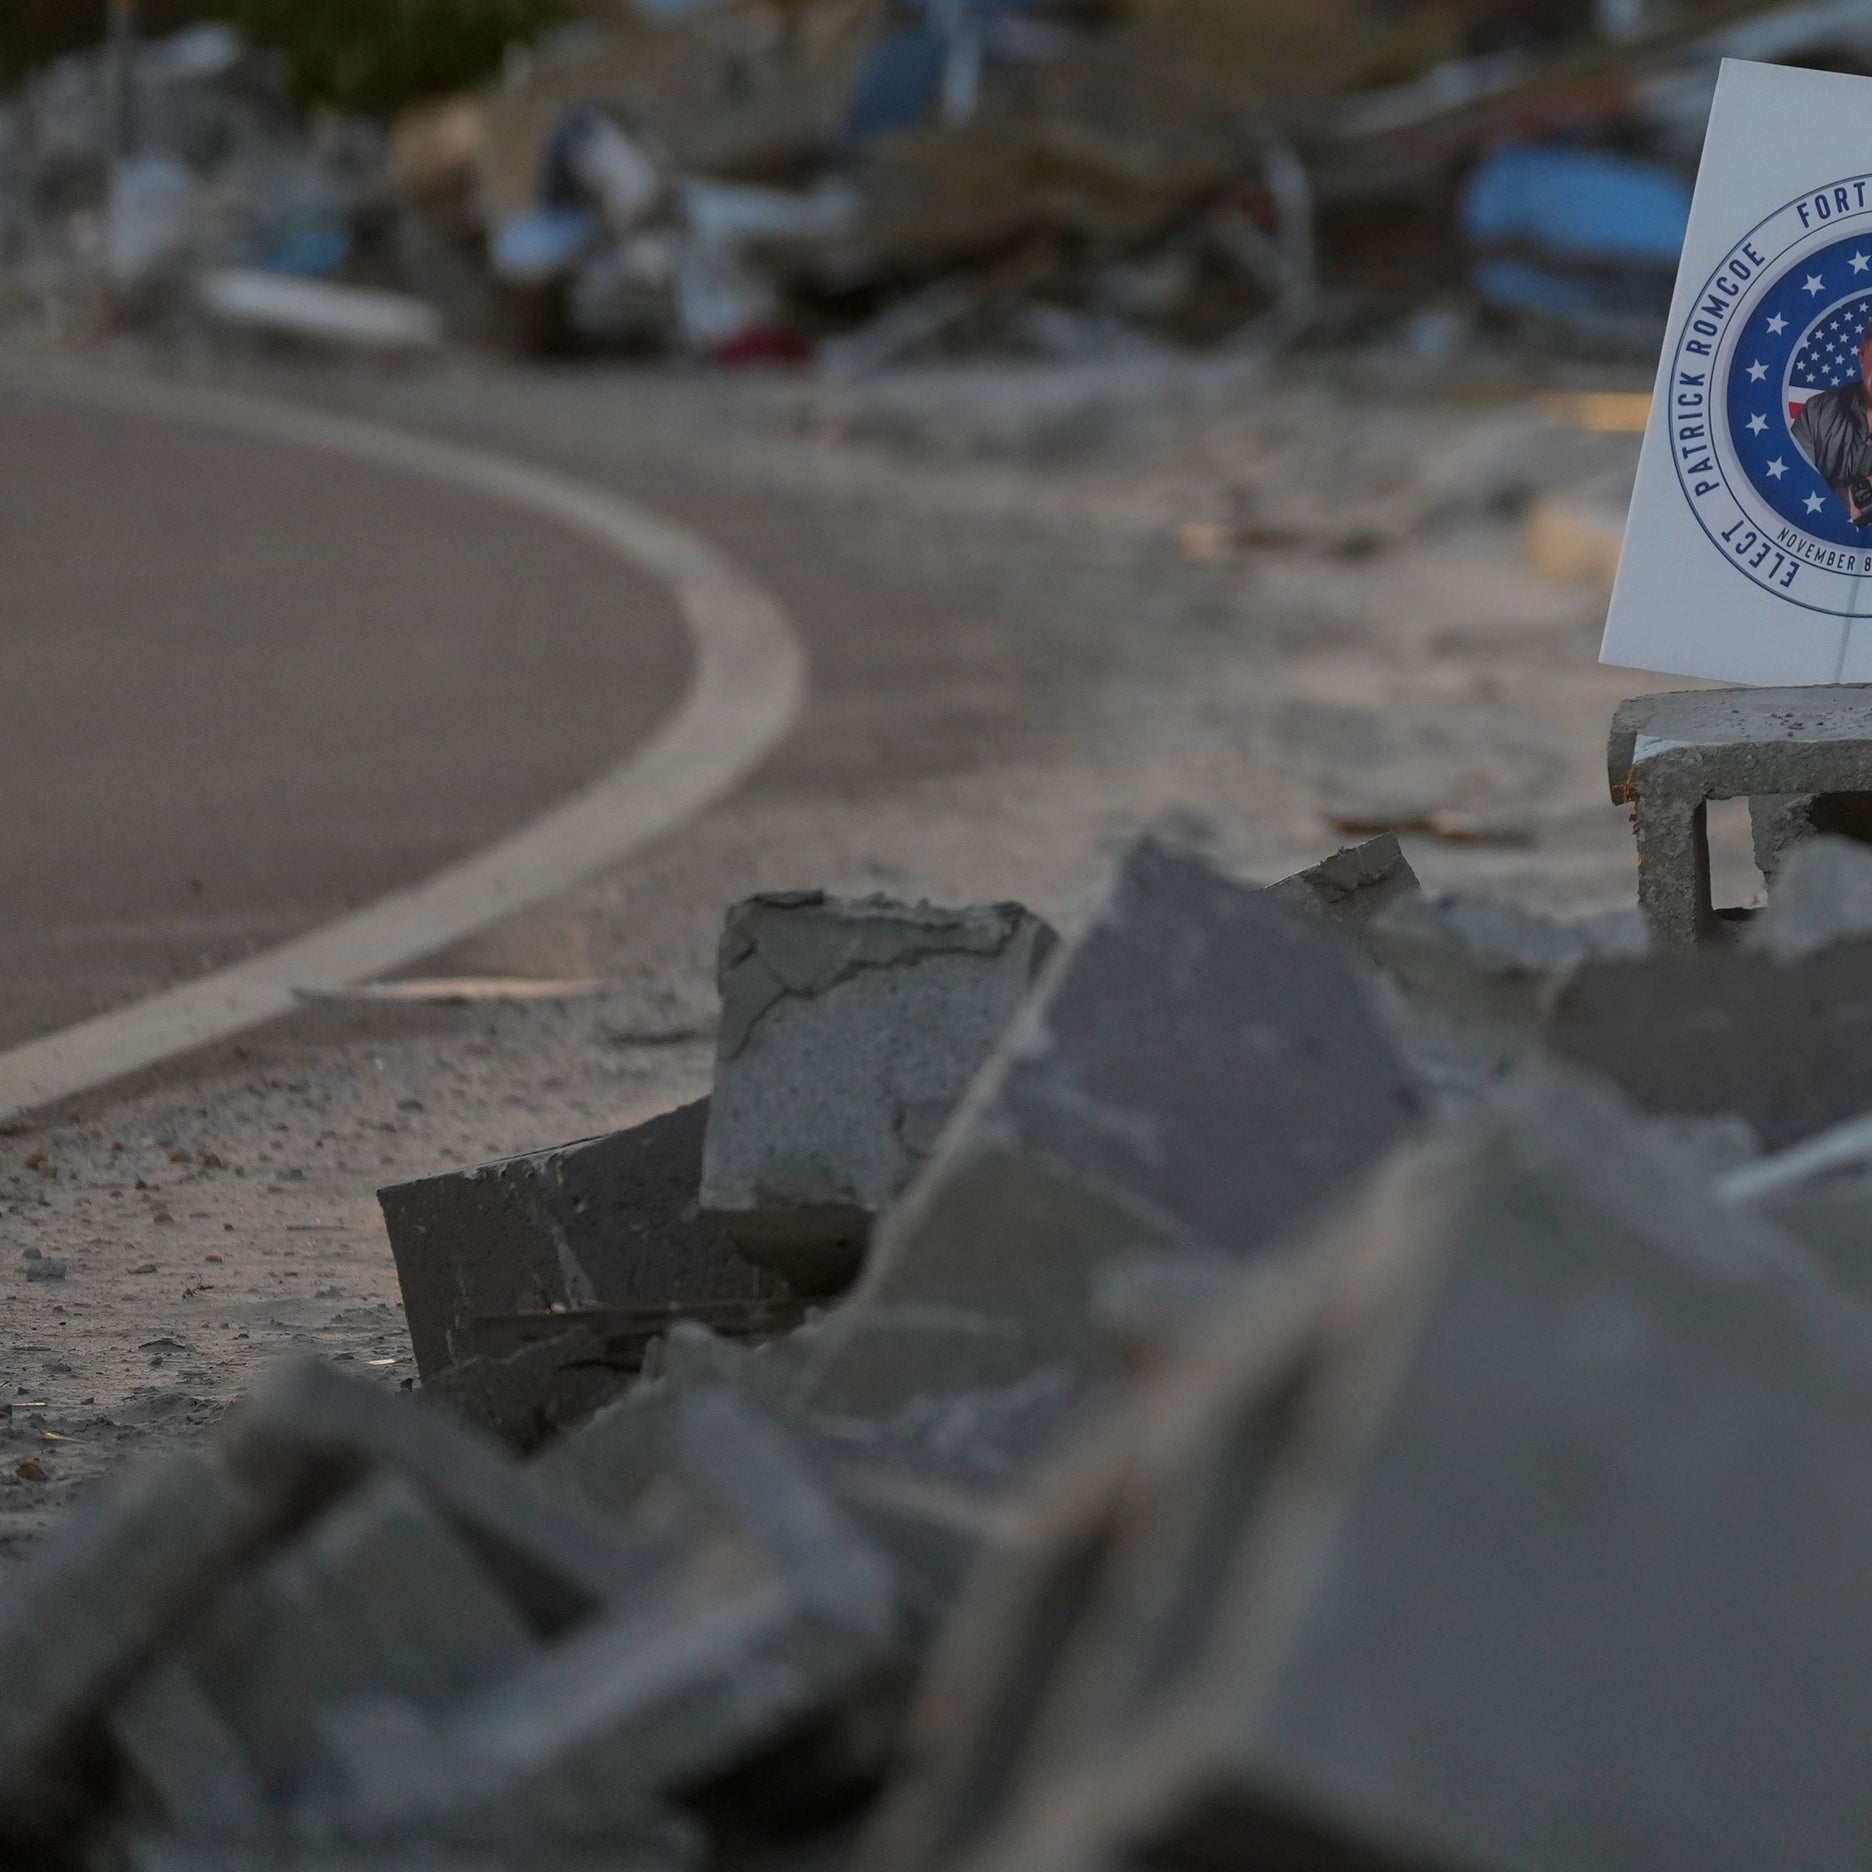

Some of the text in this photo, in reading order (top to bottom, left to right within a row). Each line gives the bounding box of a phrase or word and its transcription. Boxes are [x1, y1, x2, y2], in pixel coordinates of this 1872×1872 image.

[1797, 181, 1866, 228] FORT
[1679, 242, 1800, 588] ELECT PATRICK ROMCOE
[1777, 526, 1855, 571] NOVEMBER
